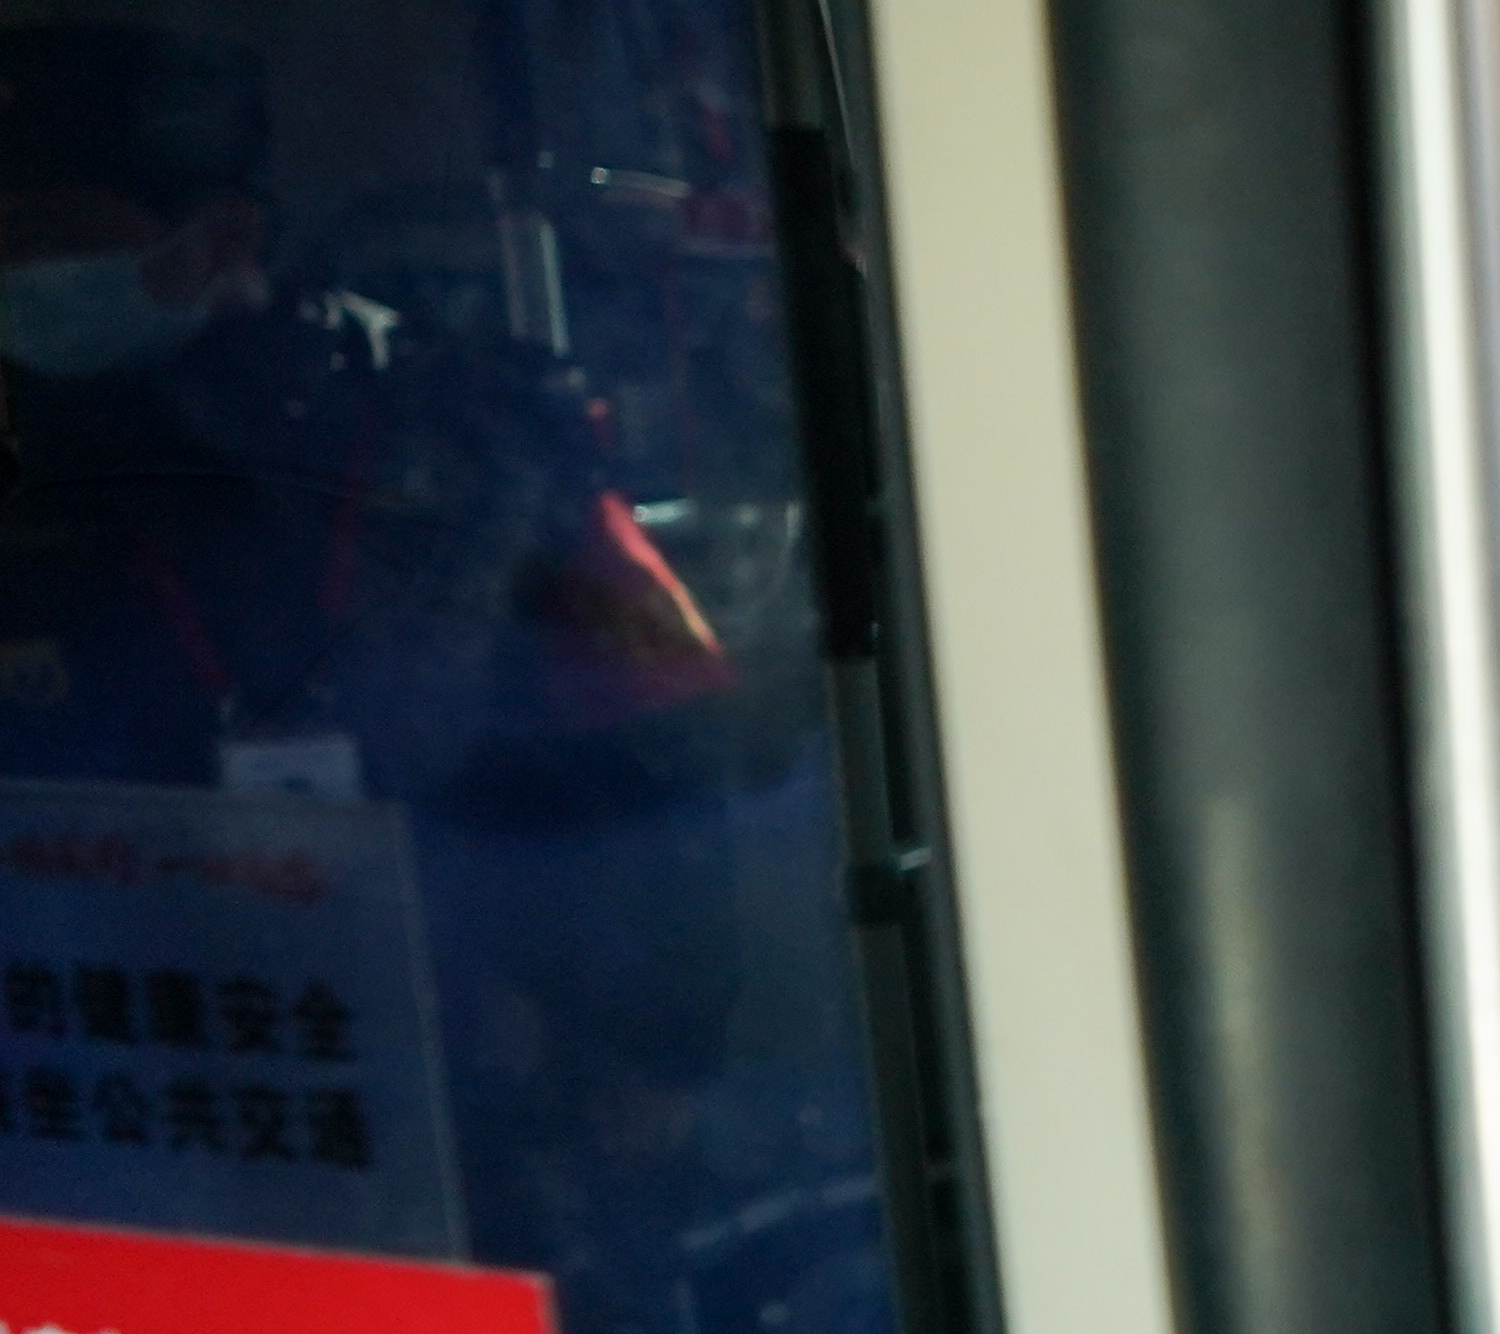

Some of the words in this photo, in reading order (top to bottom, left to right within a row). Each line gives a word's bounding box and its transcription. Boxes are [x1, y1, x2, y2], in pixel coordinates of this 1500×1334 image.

[0, 1065, 373, 1169] 坐公共交通
